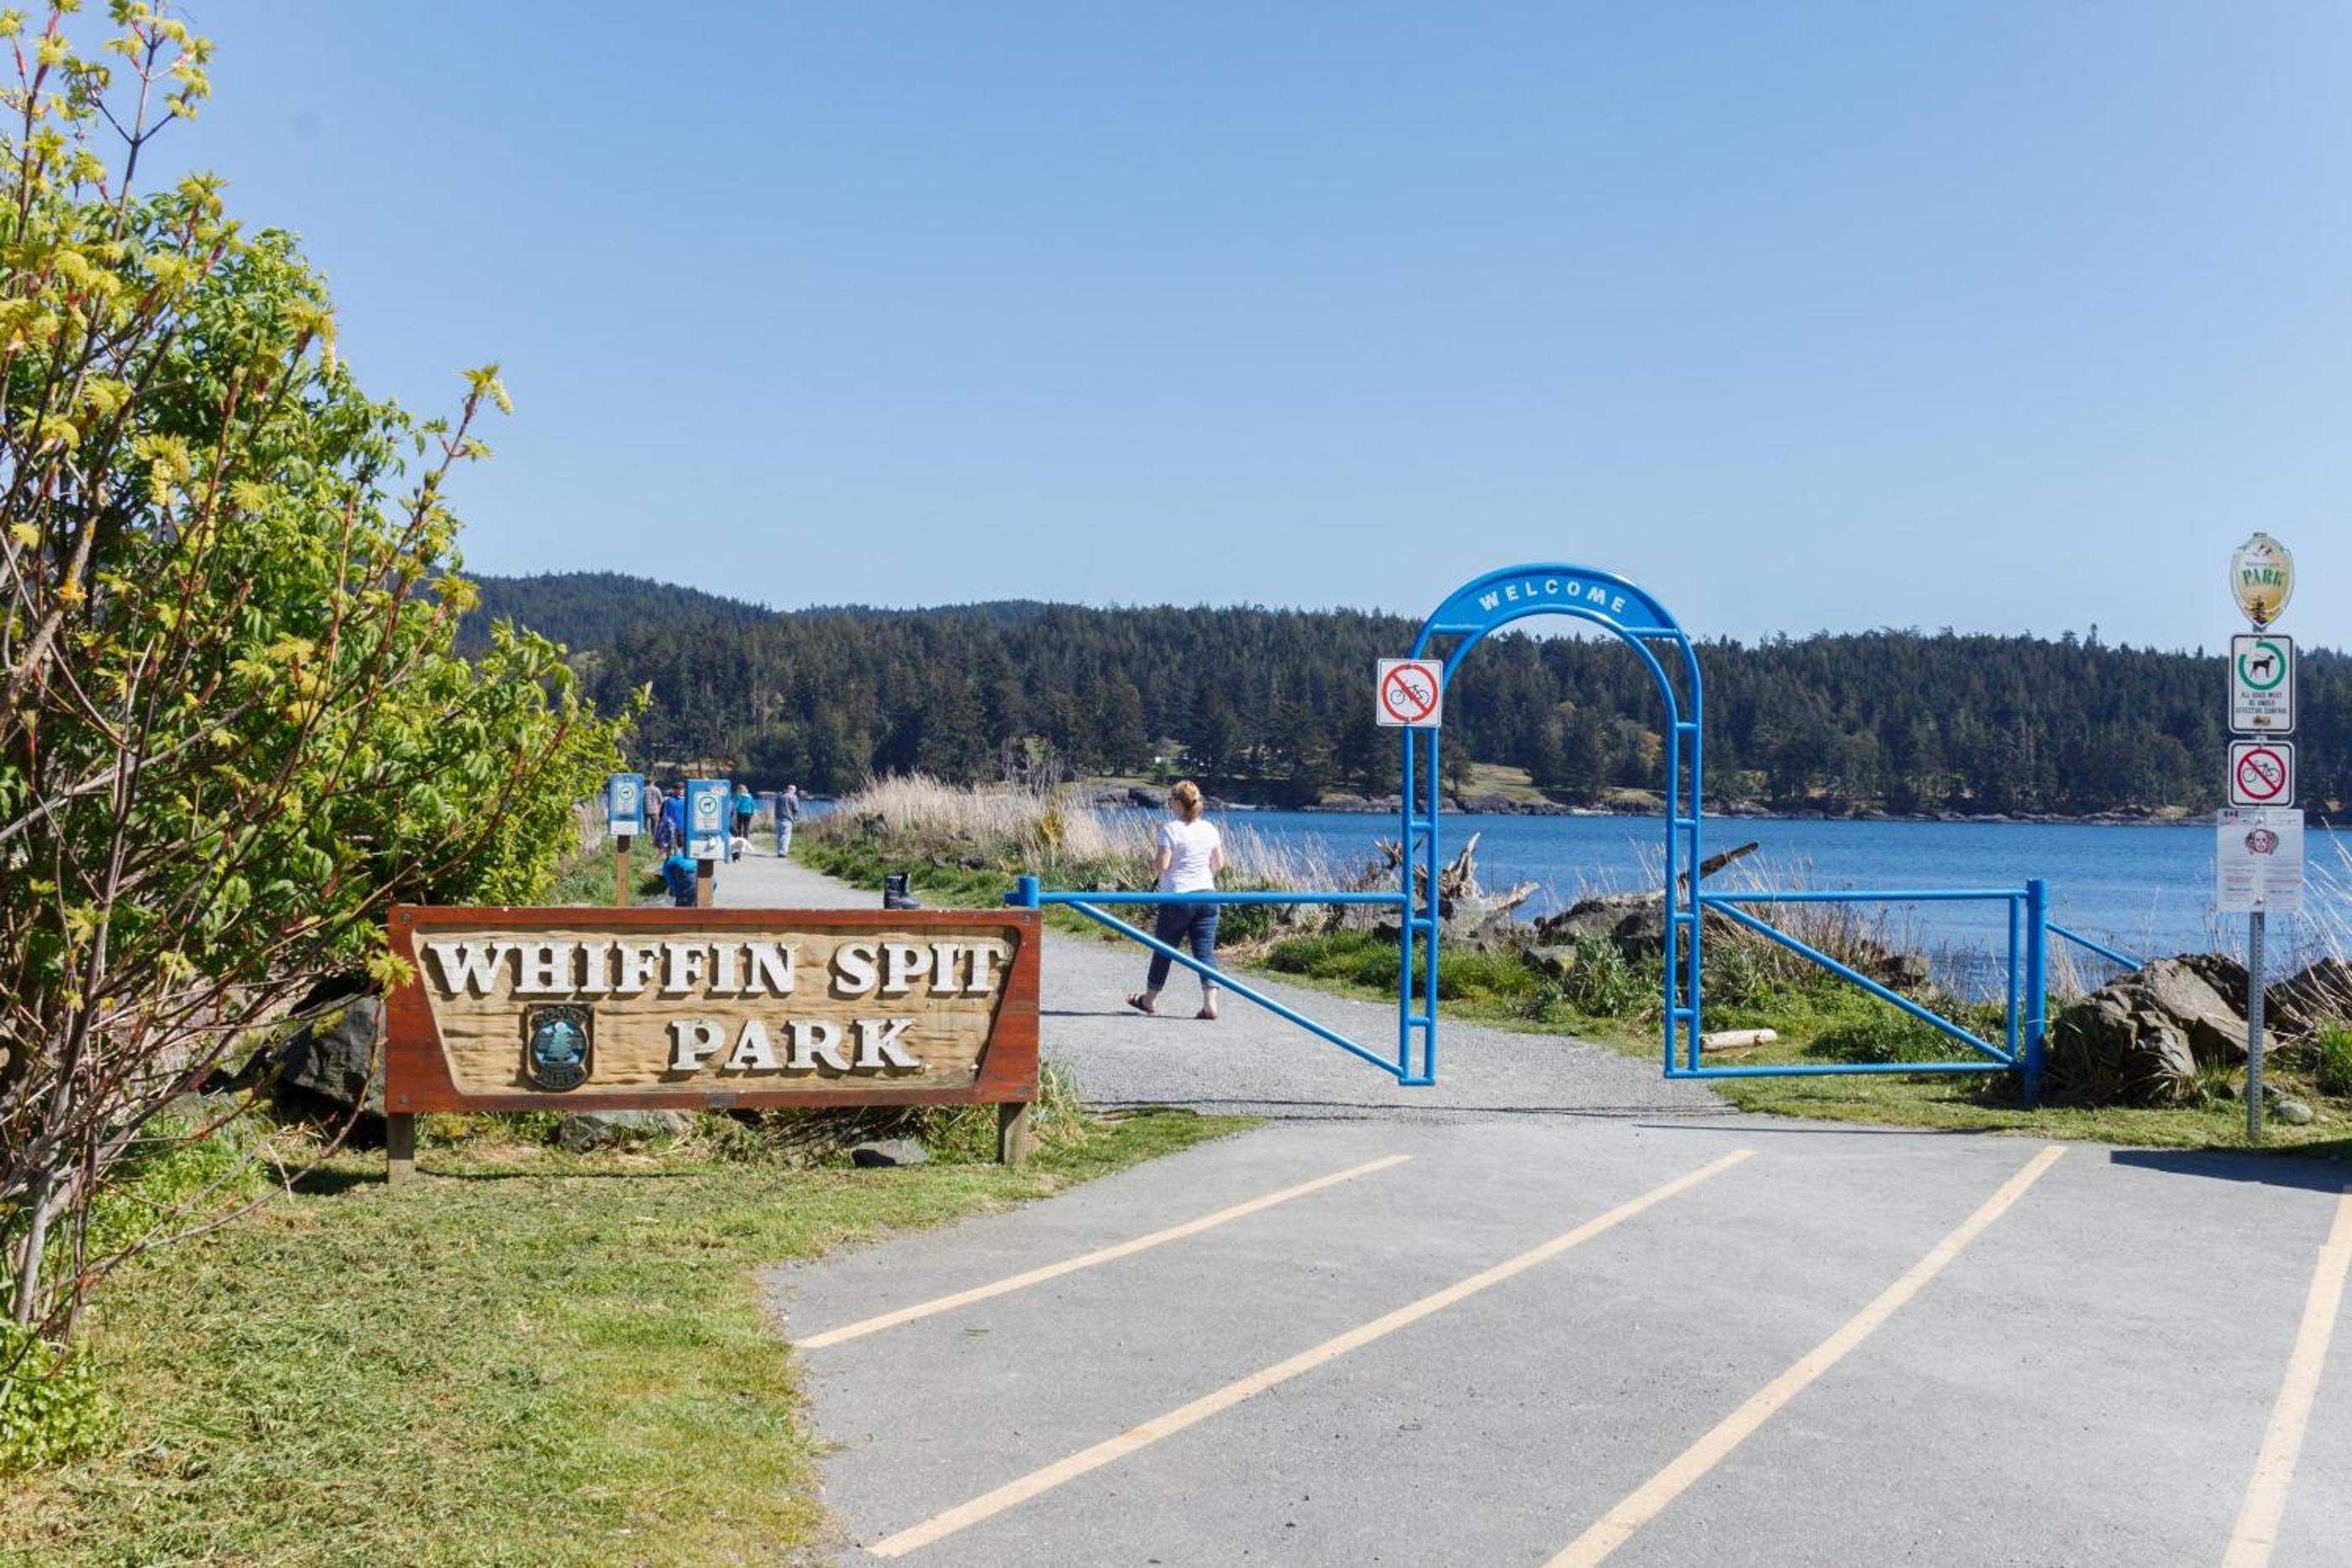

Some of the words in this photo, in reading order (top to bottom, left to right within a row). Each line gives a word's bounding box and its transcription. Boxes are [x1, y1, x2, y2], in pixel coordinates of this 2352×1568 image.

[1480, 579, 1625, 612] WELCOME
[2242, 568, 2283, 587] PARK
[428, 941, 802, 994] WHIFFIN
[835, 941, 1007, 994] SPIT
[671, 1019, 920, 1070] PARK
